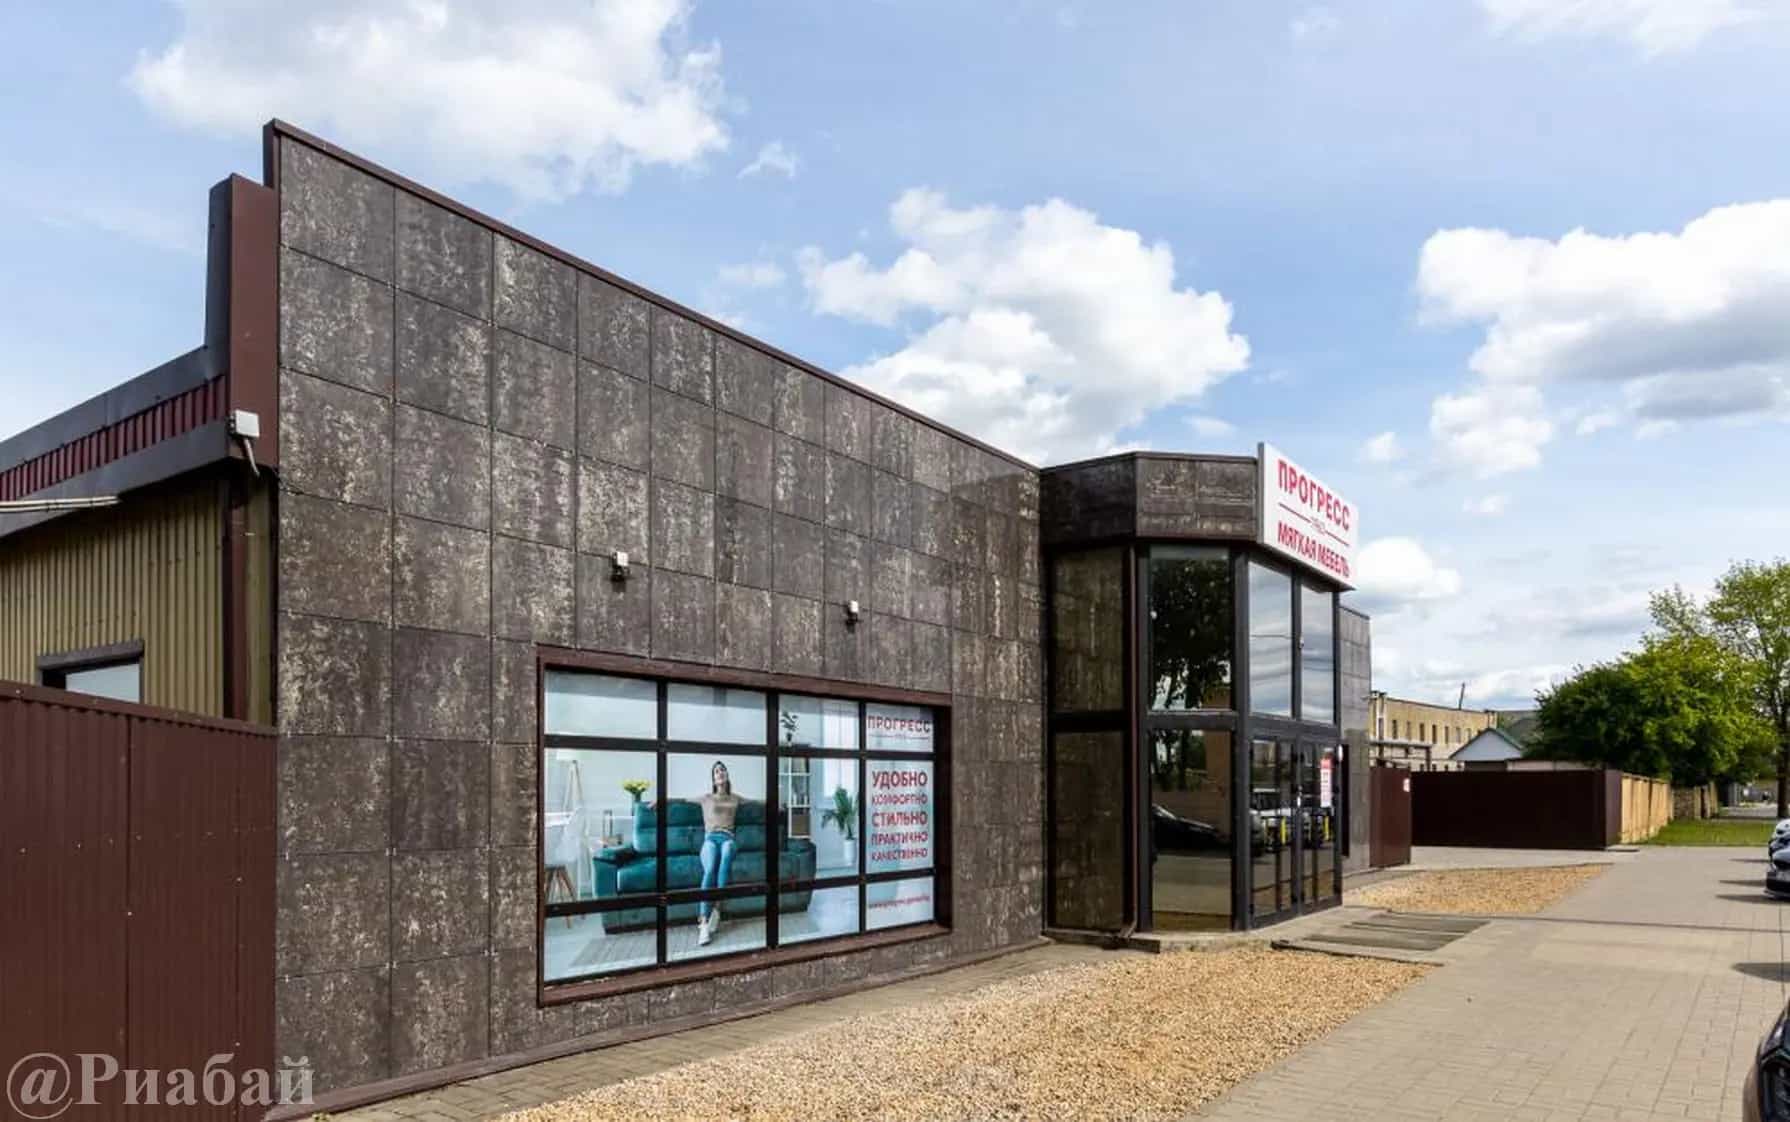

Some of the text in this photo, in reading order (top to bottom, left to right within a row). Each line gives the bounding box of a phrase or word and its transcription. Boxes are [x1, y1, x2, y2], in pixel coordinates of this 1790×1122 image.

[1278, 459, 1350, 531] ПРОГРЕСС
[1278, 522, 1349, 578] МЯГКАЯ МЕБЕЛЬ
[868, 715, 930, 732] ПРОГРЕСС
[872, 771, 928, 789] УДОБНО
[872, 811, 928, 827] СТИЛЬНО
[872, 831, 928, 845] ПРАКТИЧНО
